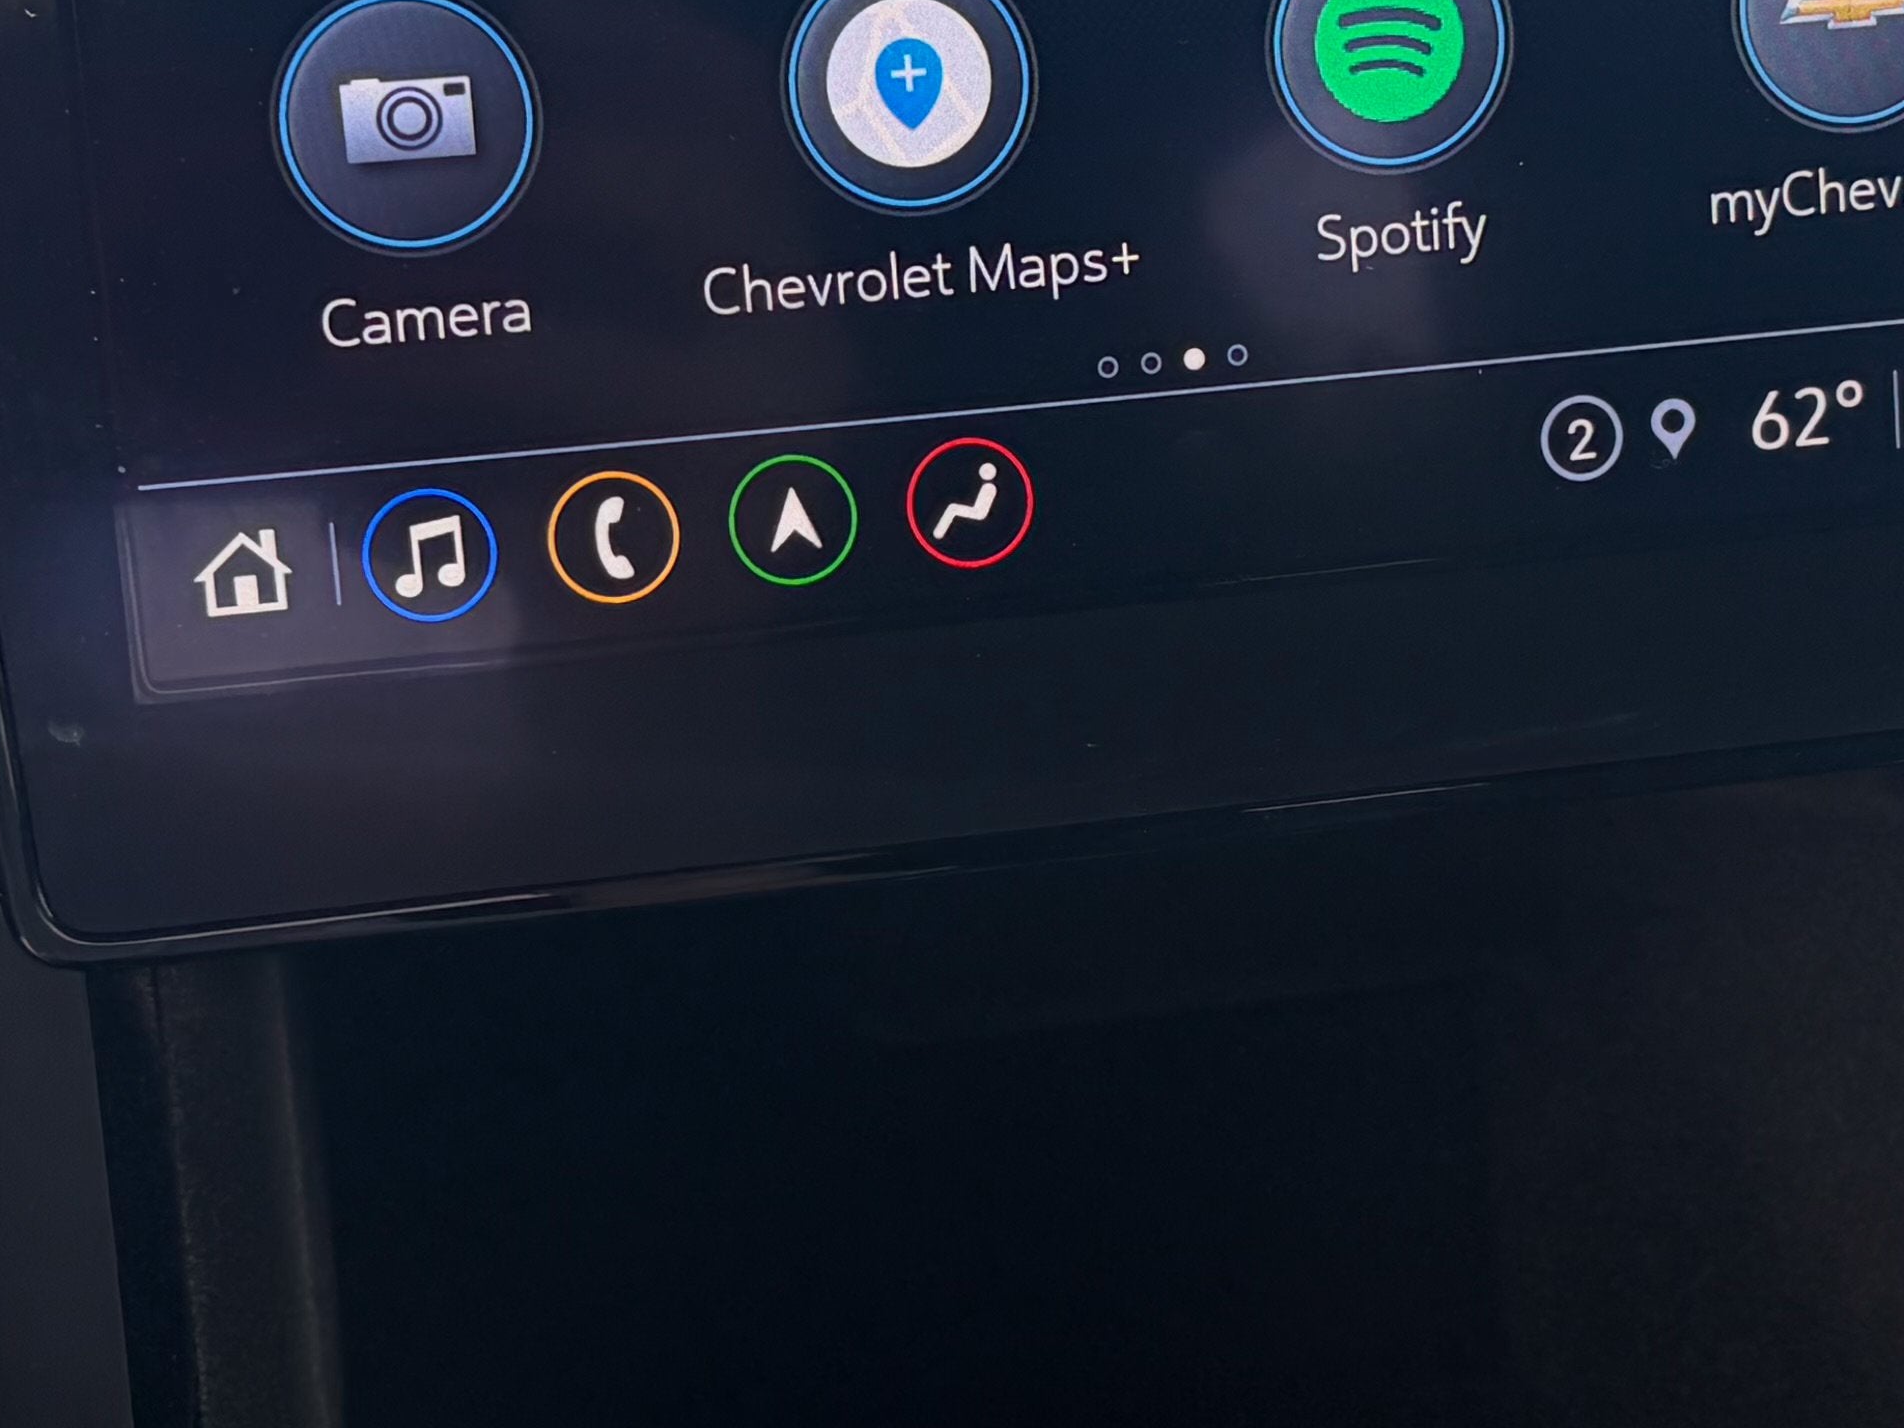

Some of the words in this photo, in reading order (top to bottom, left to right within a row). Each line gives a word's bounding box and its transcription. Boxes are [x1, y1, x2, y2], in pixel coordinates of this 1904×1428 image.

[1316, 199, 1488, 273] Spotify
[702, 249, 955, 316] Chevrolet
[969, 241, 1140, 301] Maps+
[321, 297, 533, 349] Camera
[1566, 417, 1598, 463] 2
[1750, 378, 1864, 451] 62°
